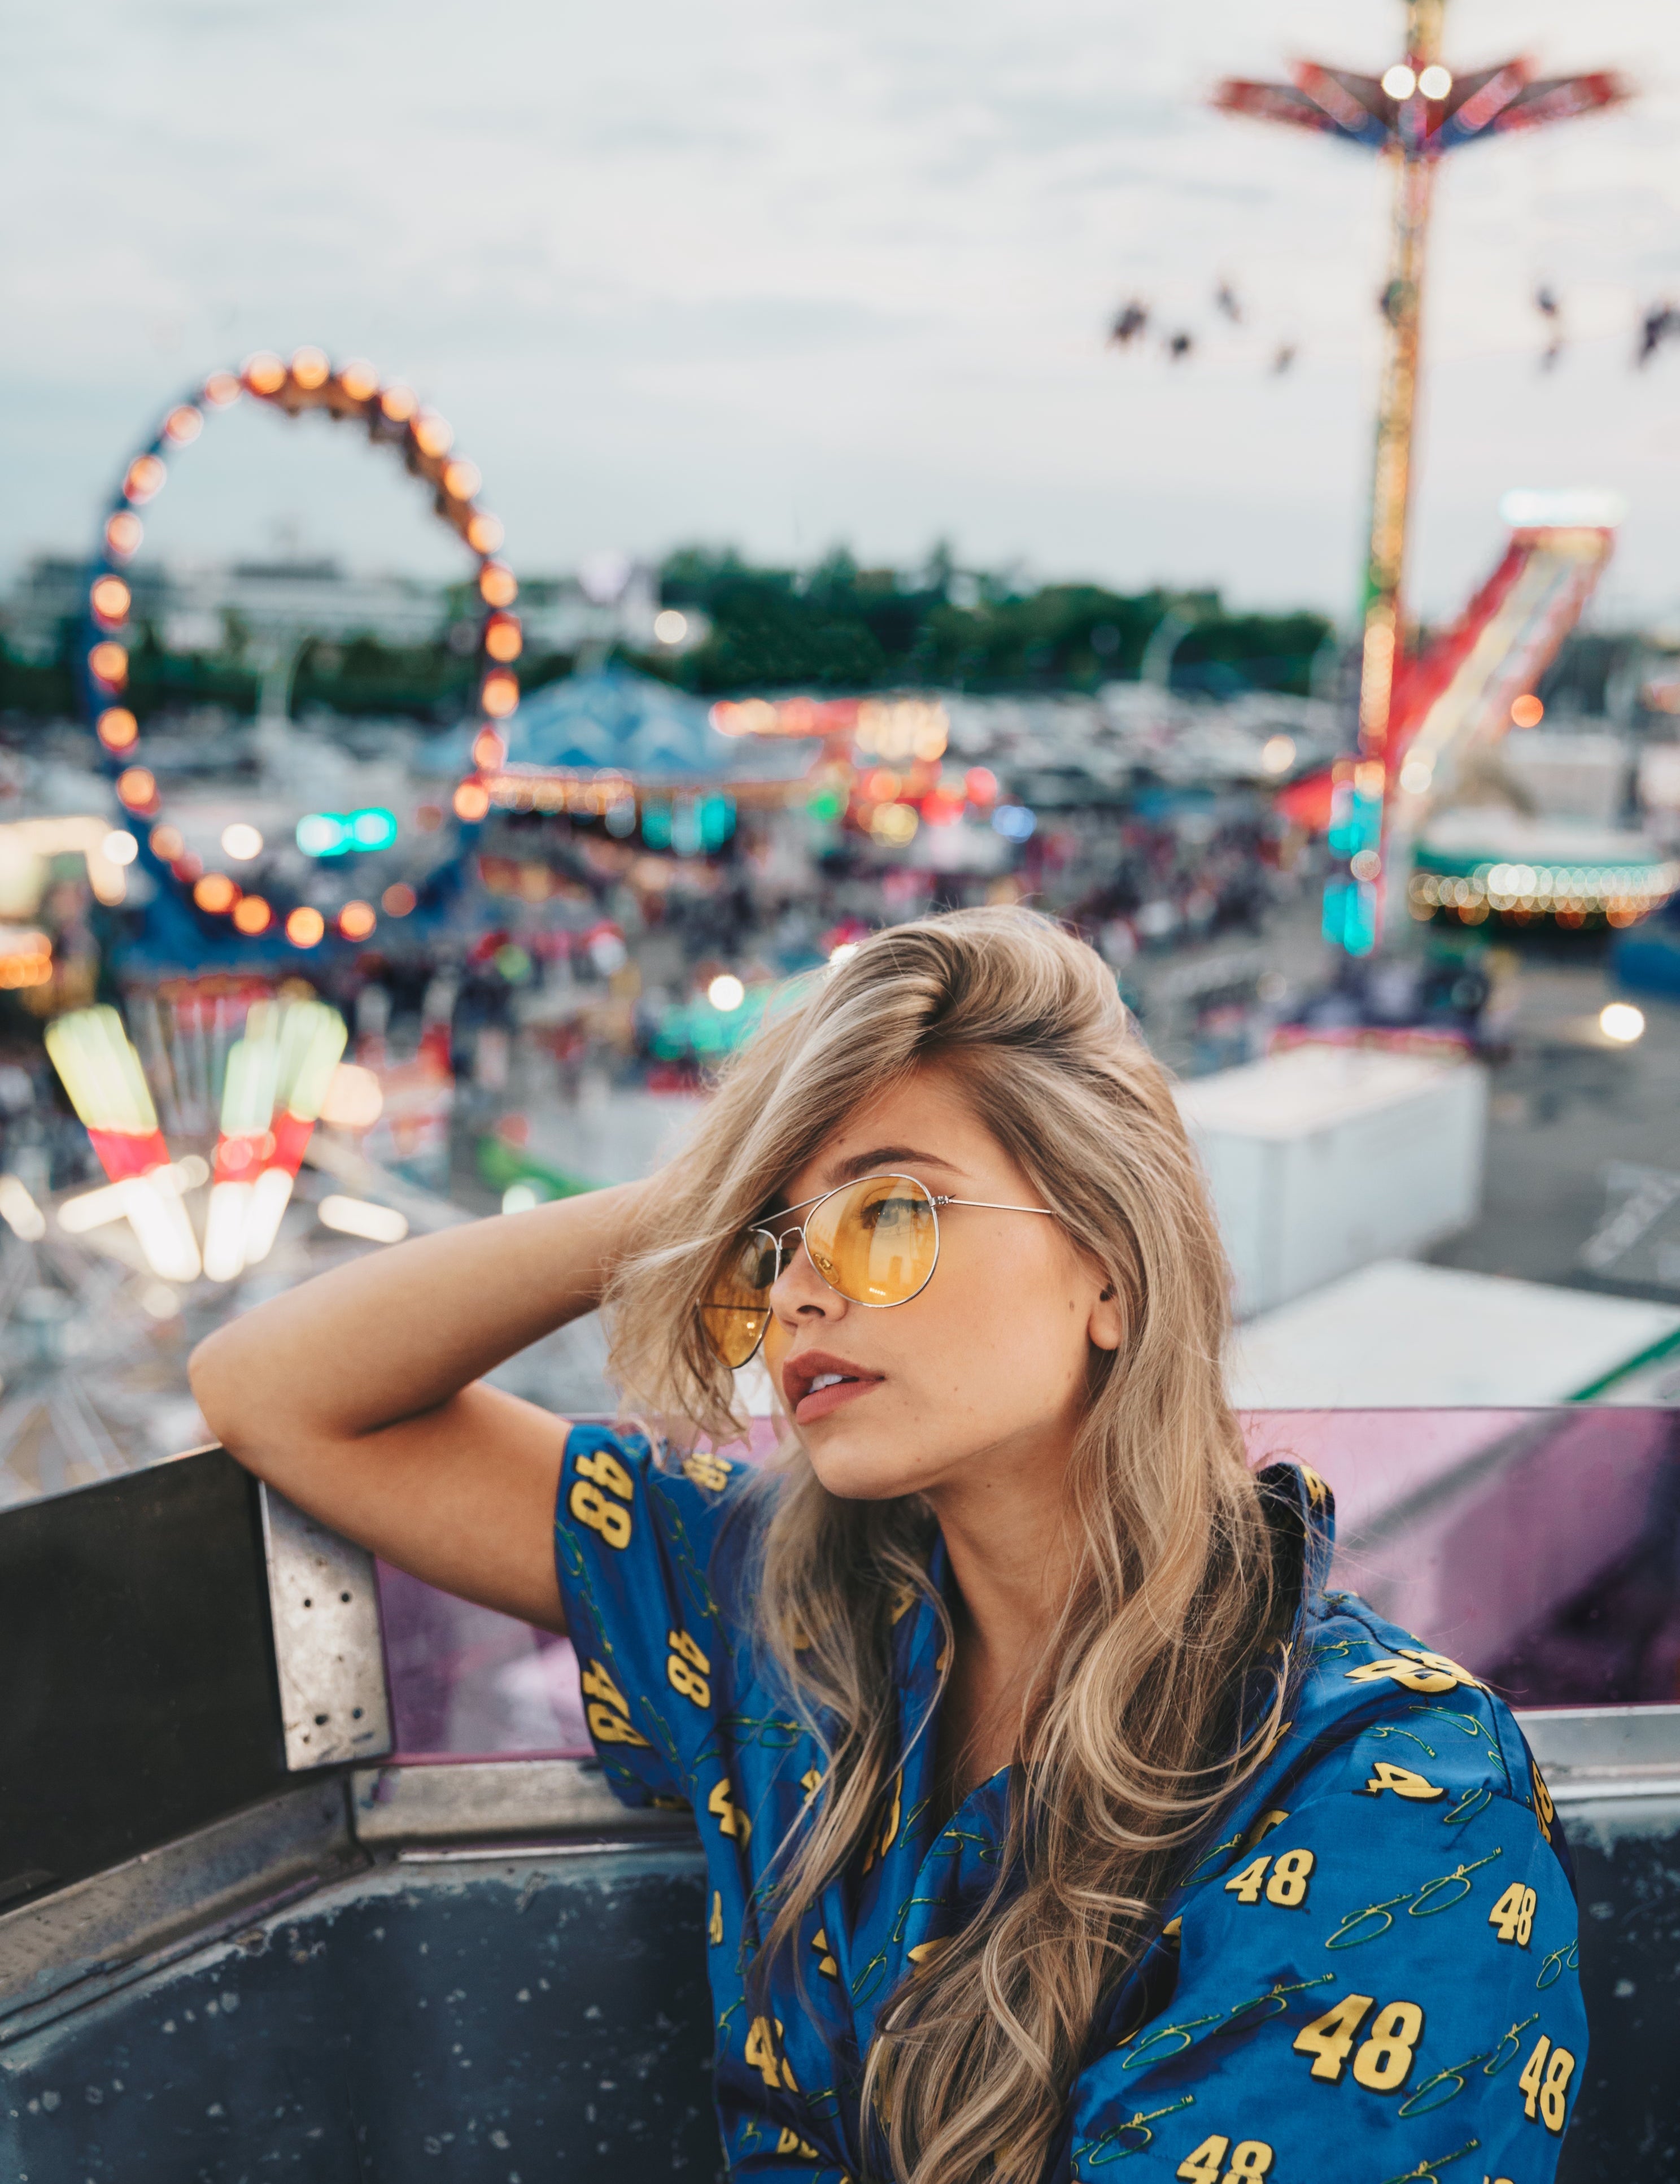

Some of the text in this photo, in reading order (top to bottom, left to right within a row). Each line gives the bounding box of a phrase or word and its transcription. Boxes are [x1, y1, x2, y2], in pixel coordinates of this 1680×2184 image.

[569, 1449, 634, 1550] 48
[582, 1657, 653, 1747] 48
[667, 1628, 711, 1709] 48
[1224, 1847, 1316, 1908] 48
[1488, 1882, 1537, 1946] 48
[1292, 1993, 1424, 2091] 48
[1518, 2033, 1576, 2133] 48
[1176, 2134, 1273, 2184] 48
